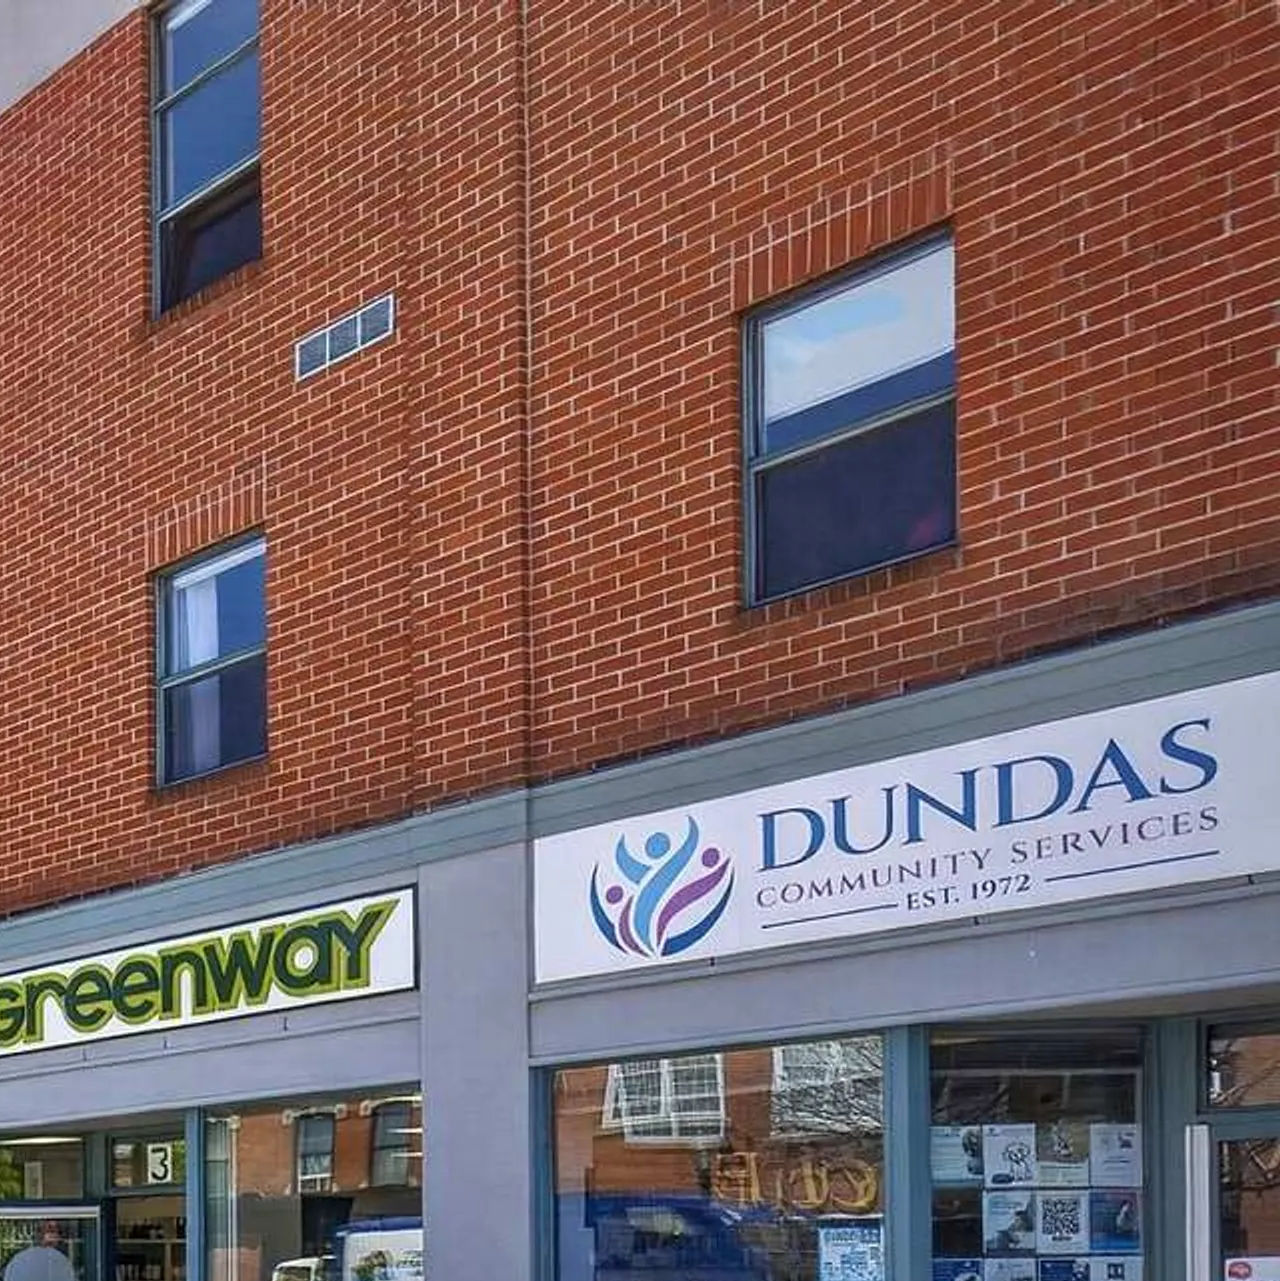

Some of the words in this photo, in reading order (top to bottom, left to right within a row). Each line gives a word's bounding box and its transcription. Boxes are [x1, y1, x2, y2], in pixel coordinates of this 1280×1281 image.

[756, 718, 1219, 874] DUNDAS
[756, 847, 992, 908] COMMUNITY
[1011, 805, 1220, 864] SERVICES
[906, 885, 960, 912] EST.
[971, 874, 1032, 901] 1972
[151, 1142, 169, 1181] 3
